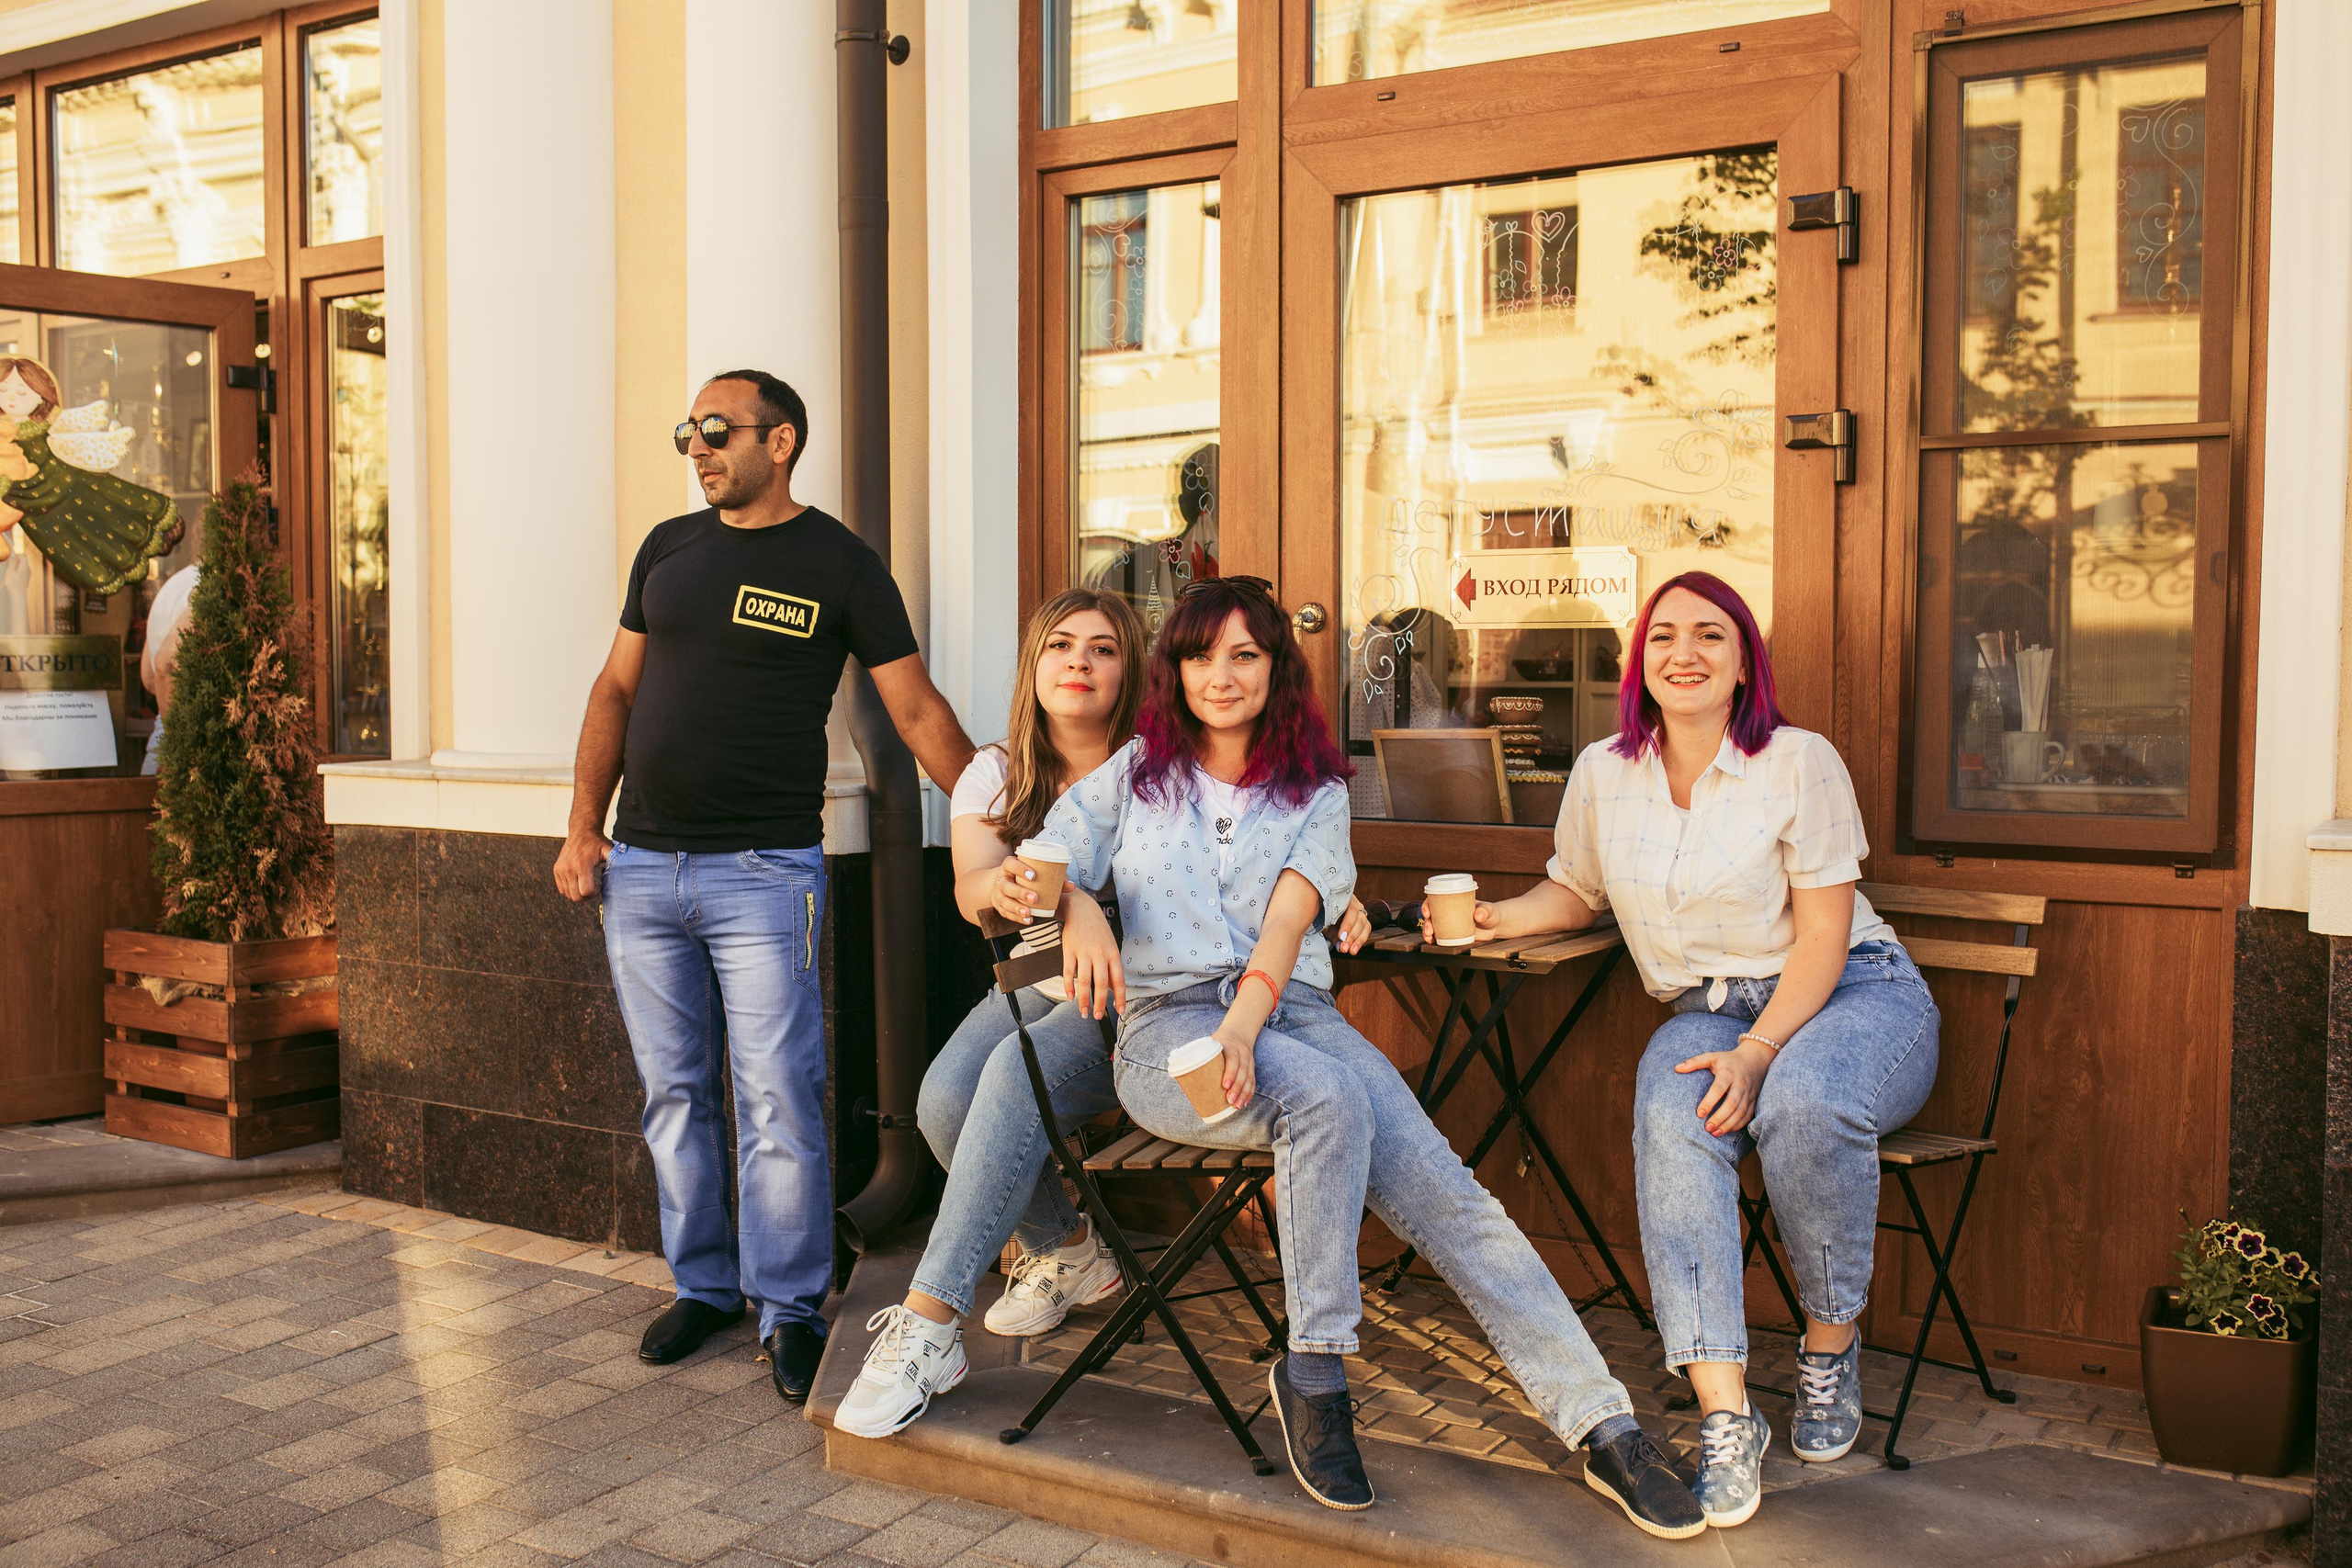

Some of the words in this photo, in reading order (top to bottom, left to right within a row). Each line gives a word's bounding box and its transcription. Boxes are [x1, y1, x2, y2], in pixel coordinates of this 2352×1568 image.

[1483, 579, 1542, 599] ВХОД
[1547, 577, 1628, 599] РЯДОМ
[745, 597, 805, 627] ОХРАНА
[0, 654, 111, 672] ТКРЫТО
